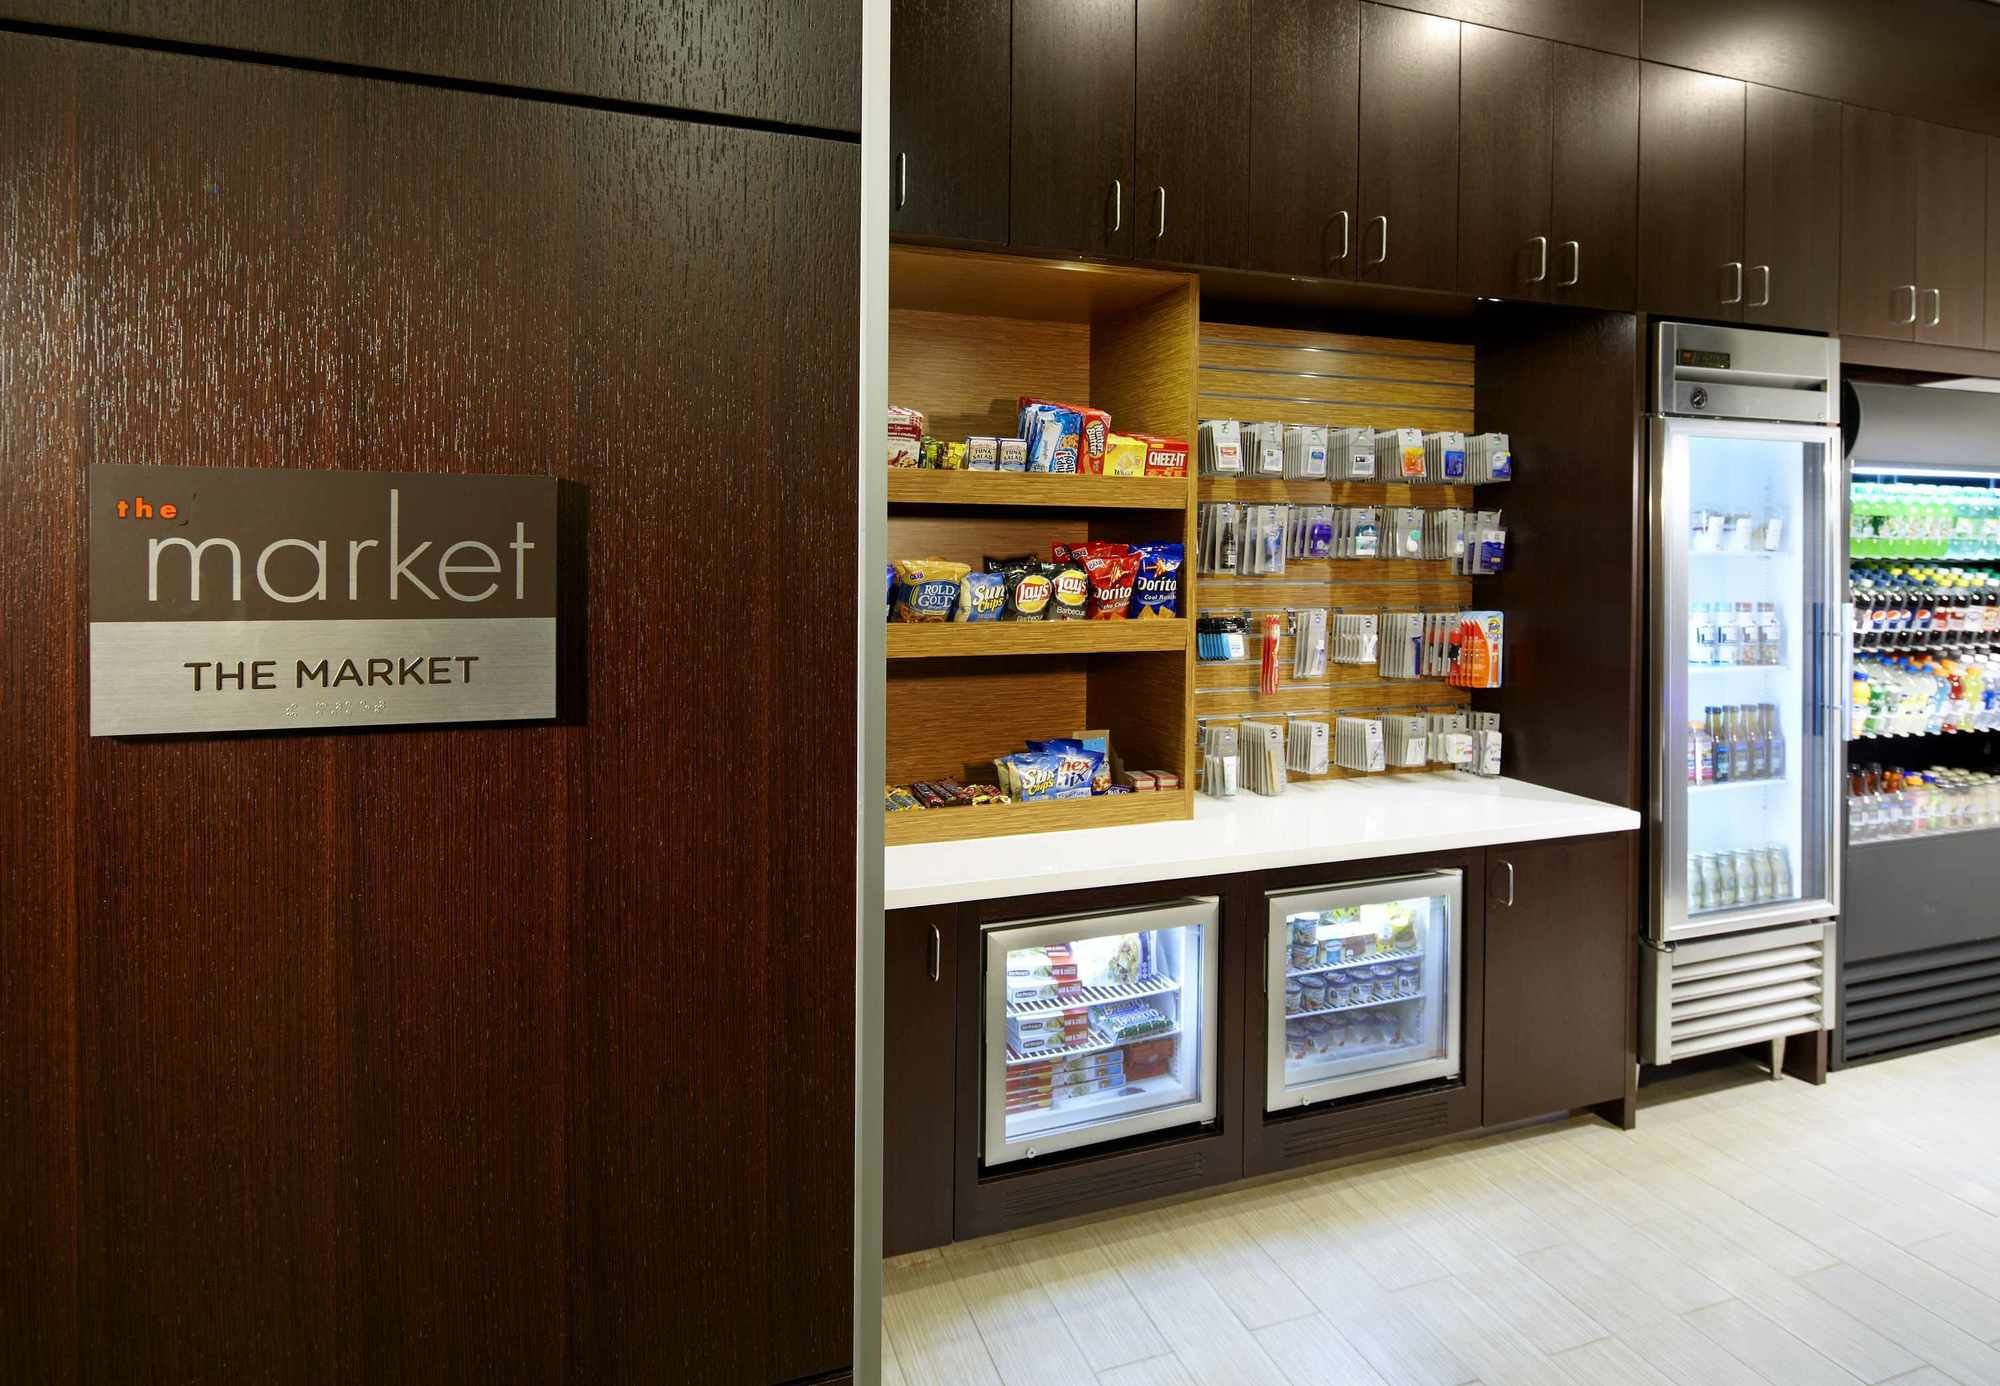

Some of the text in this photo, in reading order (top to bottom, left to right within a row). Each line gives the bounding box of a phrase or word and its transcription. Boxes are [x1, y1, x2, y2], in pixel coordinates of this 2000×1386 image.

[116, 496, 178, 520] the
[148, 488, 537, 604] market
[924, 584, 955, 596] ROLD
[974, 585, 1005, 605] Sun
[918, 595, 954, 608] GOLD
[979, 598, 1004, 613] Chips
[184, 656, 480, 691] THE MARKET
